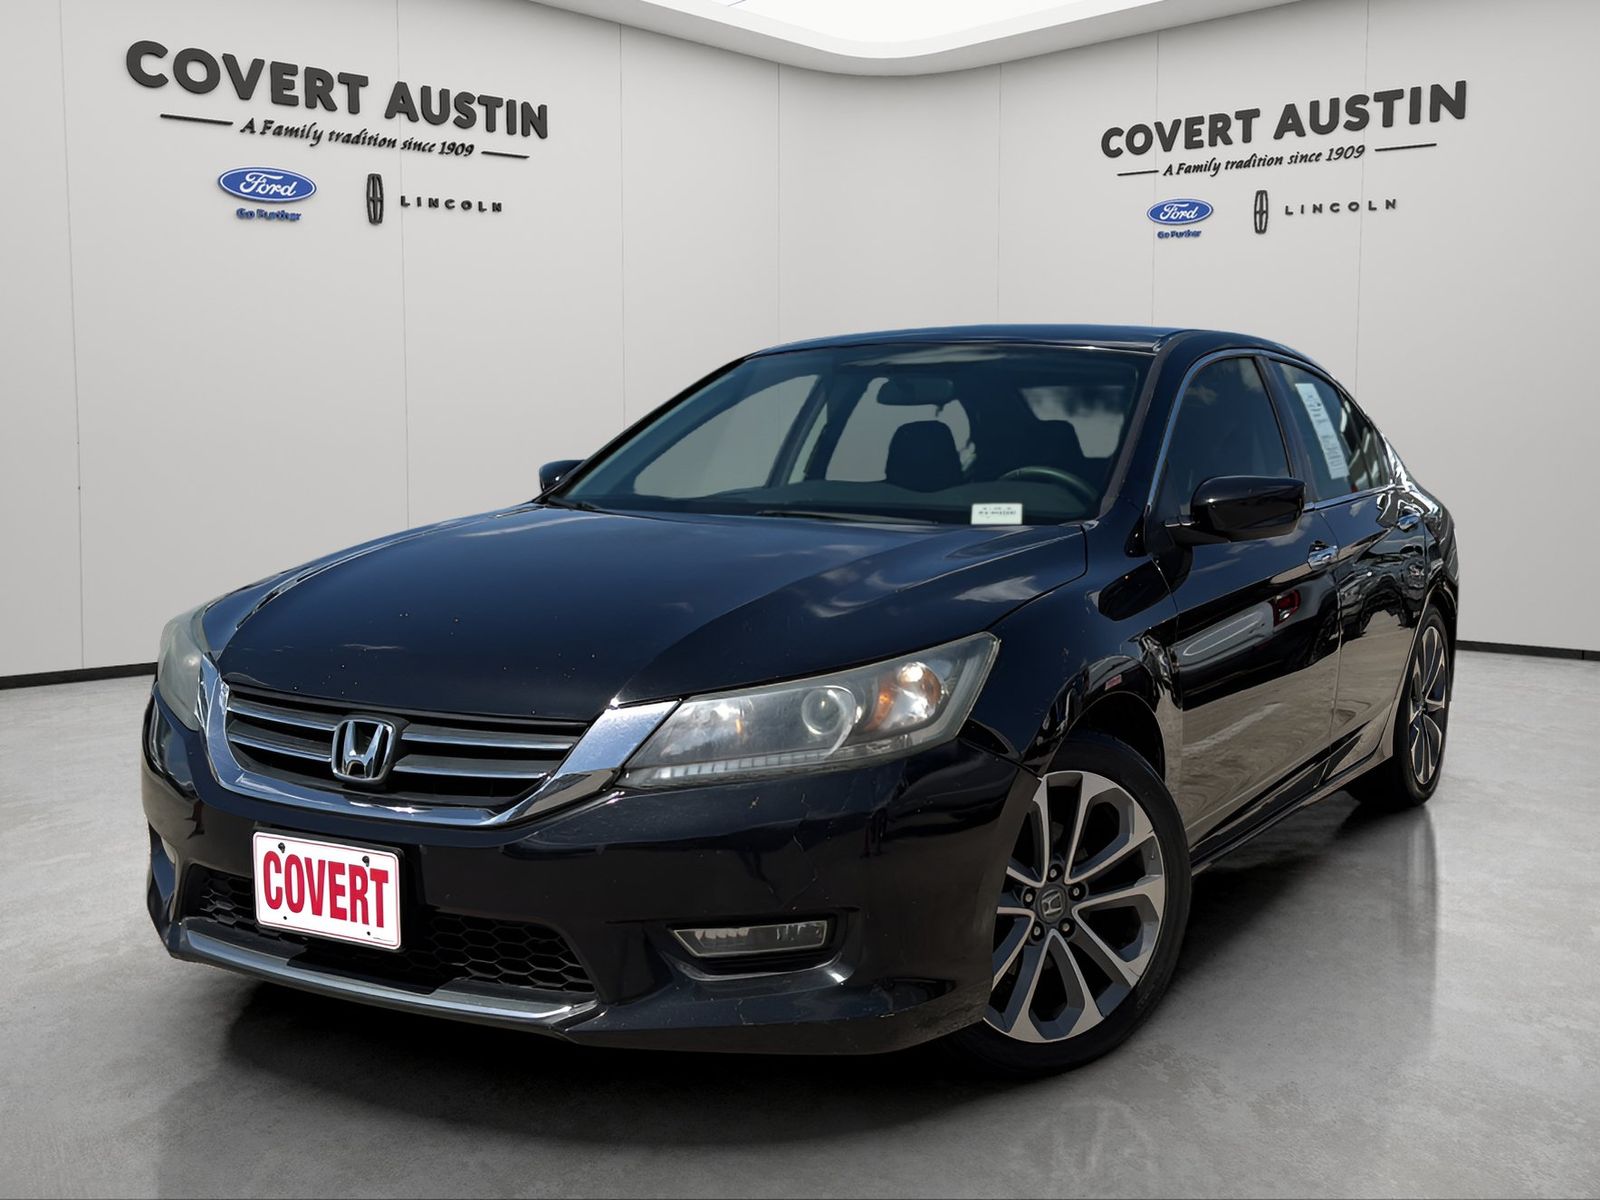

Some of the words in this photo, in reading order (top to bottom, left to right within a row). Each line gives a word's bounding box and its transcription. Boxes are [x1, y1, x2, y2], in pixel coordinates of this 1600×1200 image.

[126, 40, 368, 115] COVERT
[384, 80, 549, 140] AUSTIN
[1100, 107, 1261, 159] COVERT
[1272, 80, 1467, 141] AUSTIN
[239, 117, 257, 135] A
[259, 119, 324, 148] Family
[328, 128, 398, 149] tradition
[400, 137, 437, 153] since
[438, 140, 475, 157] 1909
[1162, 163, 1174, 176] A
[1175, 156, 1222, 178] Family
[1224, 152, 1284, 171] tradition
[1287, 151, 1323, 165] since
[1325, 144, 1366, 162] 1909
[239, 171, 298, 197] Ford
[400, 195, 502, 213] LINCOLN
[1159, 202, 1200, 221] Ford
[1284, 198, 1397, 216] LINCOLN
[263, 850, 389, 928] COVERT
